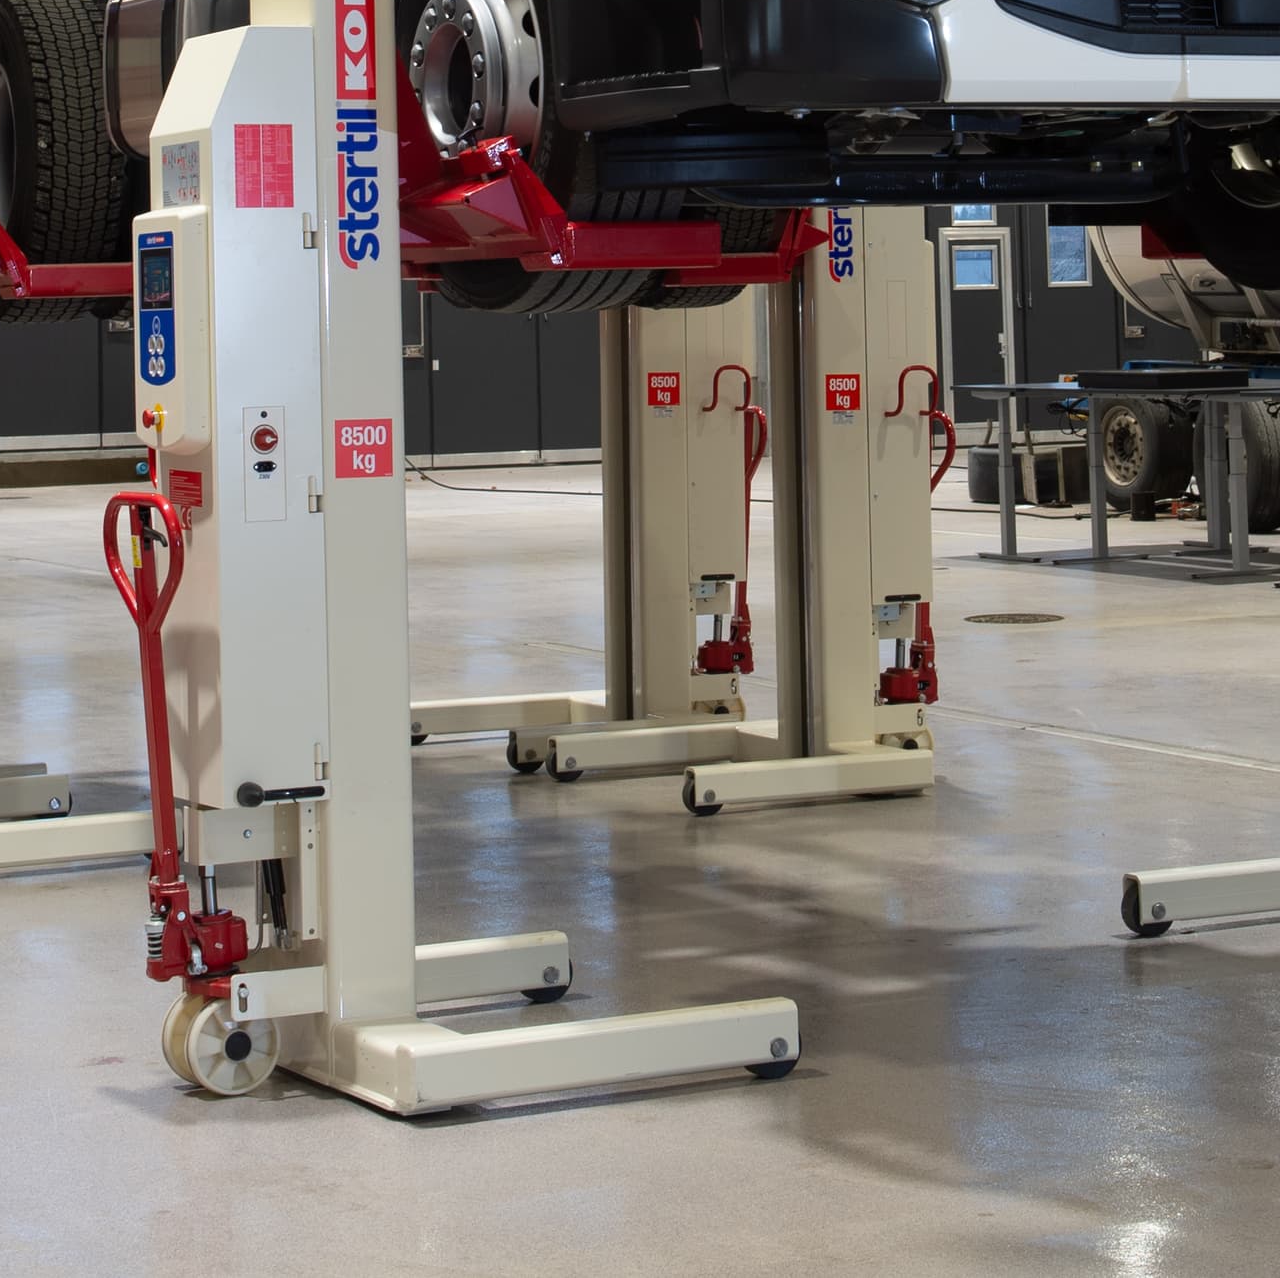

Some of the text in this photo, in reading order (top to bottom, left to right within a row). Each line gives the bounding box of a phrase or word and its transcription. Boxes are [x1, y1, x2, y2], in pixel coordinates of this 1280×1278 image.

[336, 108, 380, 269] stertil
[827, 207, 854, 283] ster
[650, 375, 677, 388] 8500
[829, 377, 857, 391] 8500
[656, 389, 671, 404] kg
[835, 392, 850, 409] kg
[340, 425, 387, 447] 8500
[352, 449, 376, 474] kg
